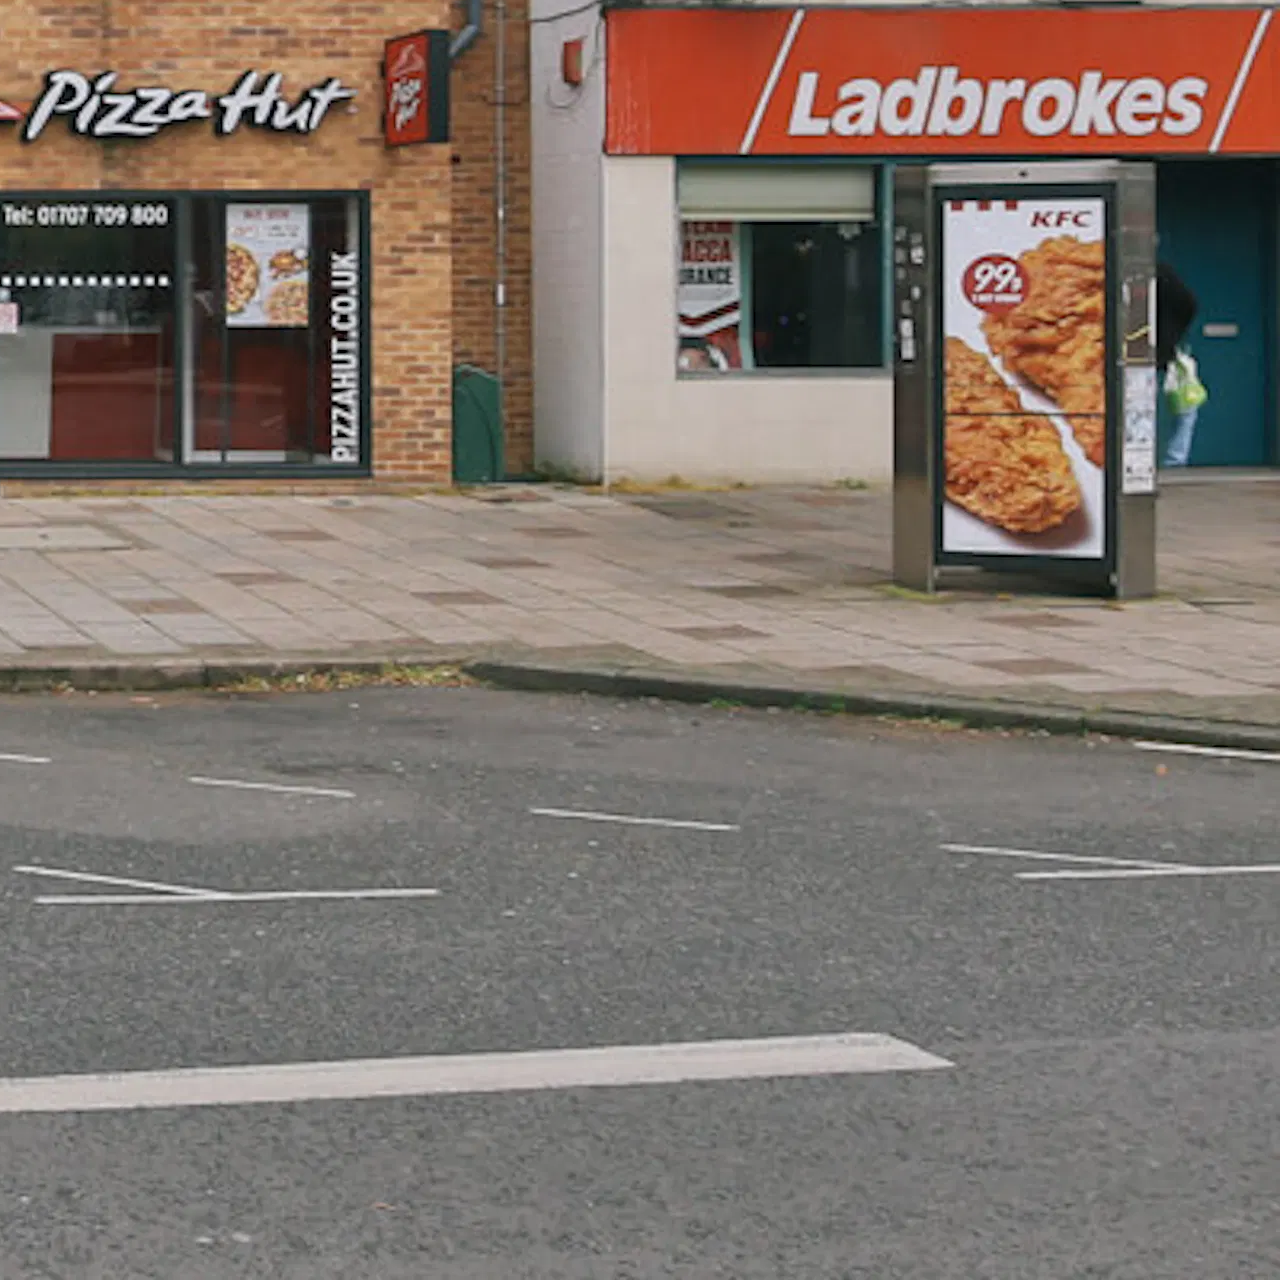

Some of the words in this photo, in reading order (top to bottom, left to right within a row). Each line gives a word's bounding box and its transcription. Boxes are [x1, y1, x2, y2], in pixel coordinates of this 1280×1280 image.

[25, 70, 211, 140] Pizza
[216, 70, 357, 134] Hut
[787, 66, 1208, 137] Ladbrokes
[2, 202, 35, 226] Tel:
[36, 202, 89, 226] 01707
[91, 202, 128, 226] 709
[130, 202, 169, 226] 800
[1030, 210, 1093, 228] KFC
[330, 251, 360, 464] PIZZAHUT.CO.UK
